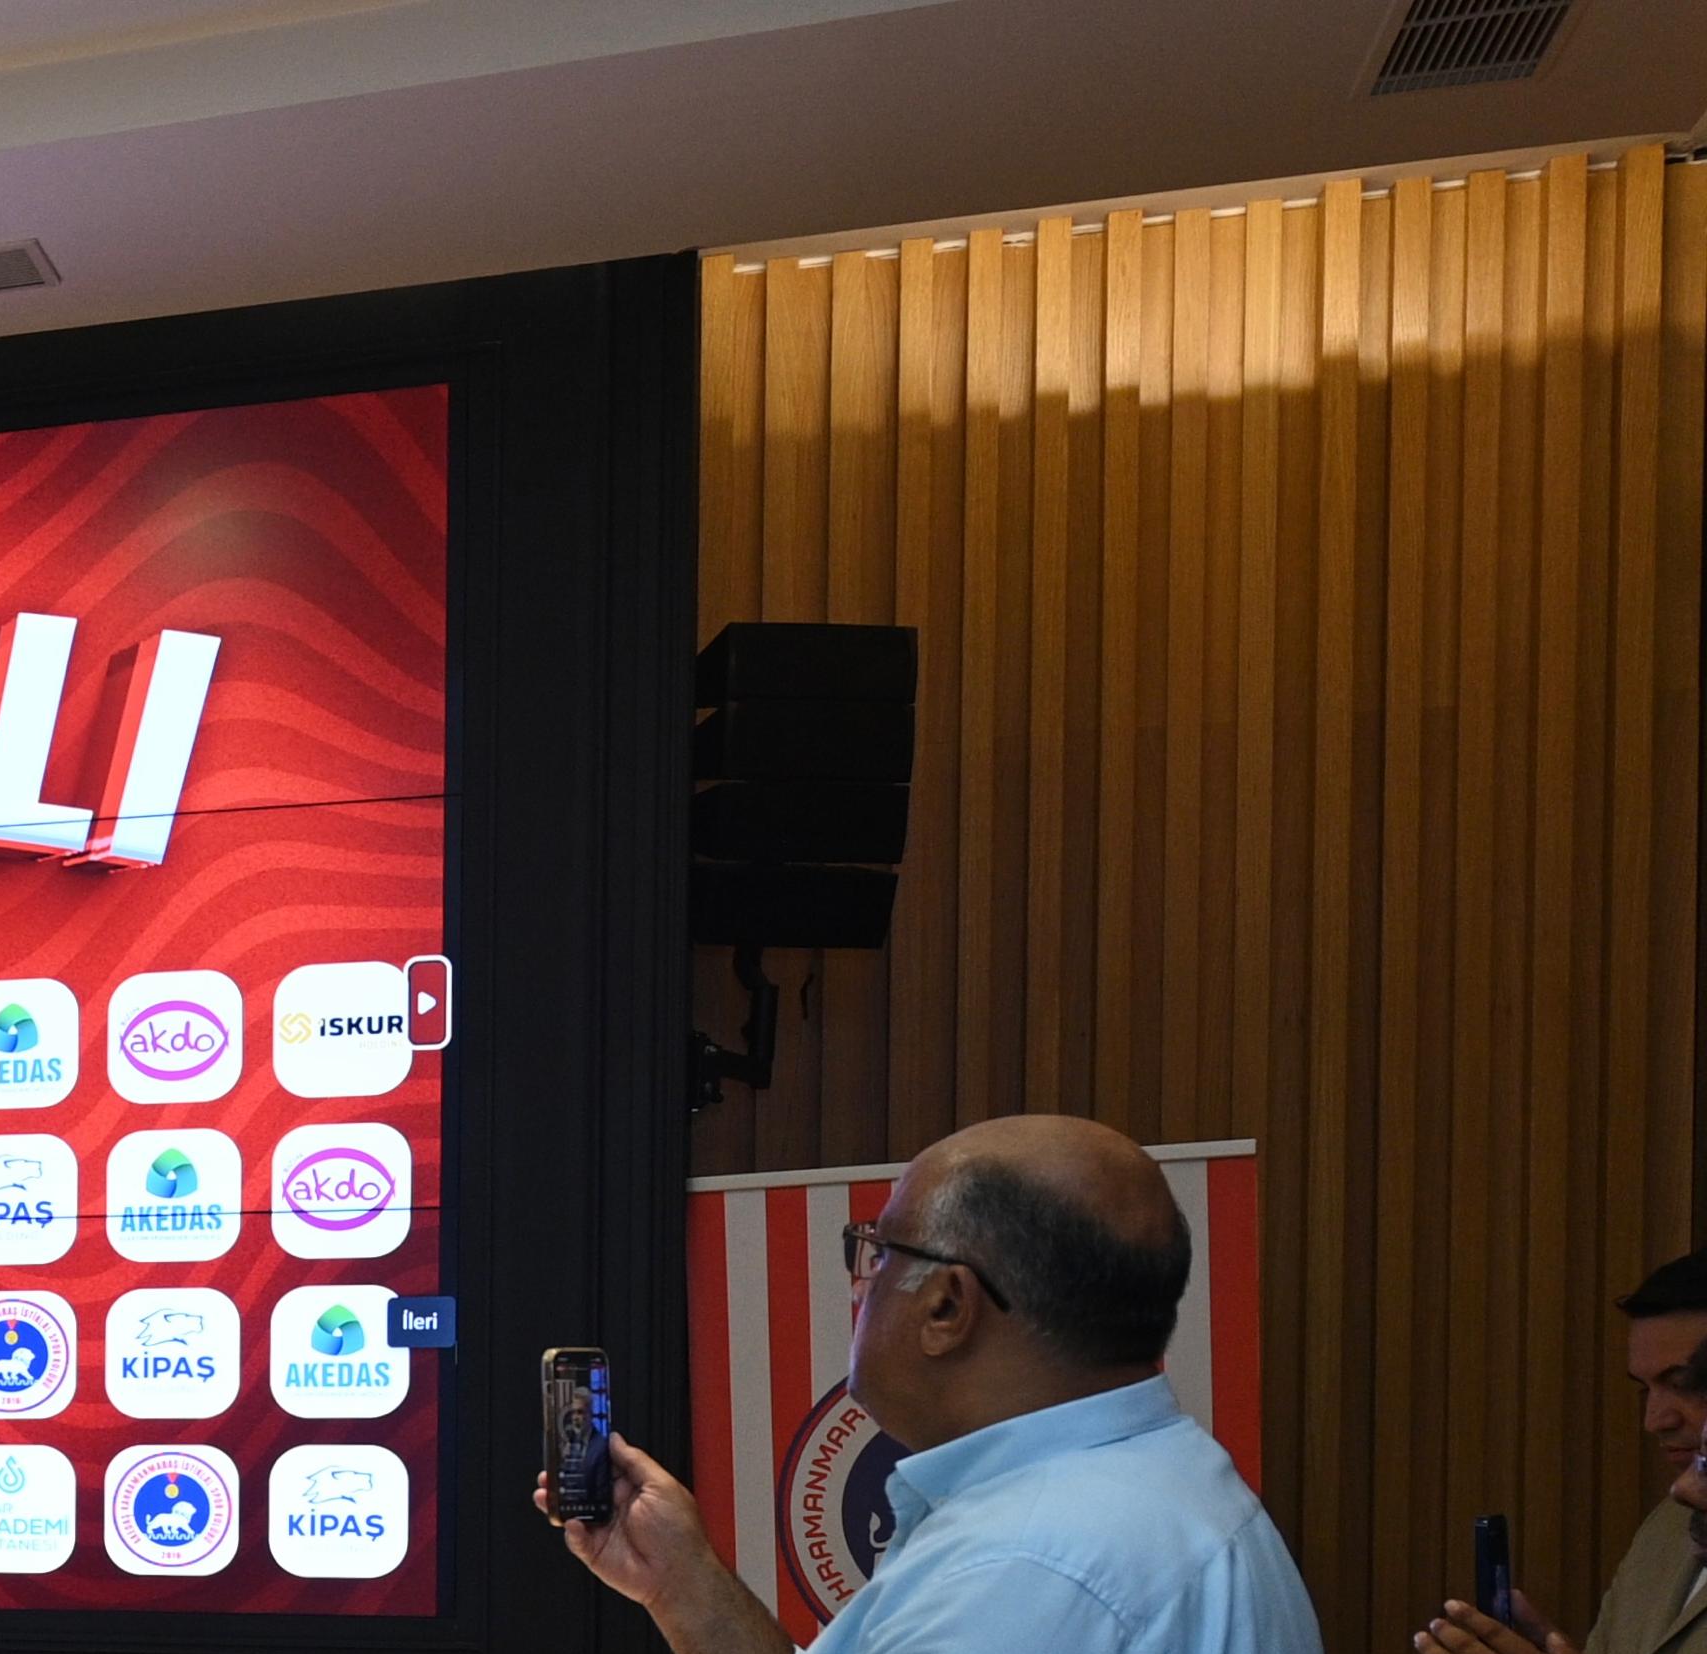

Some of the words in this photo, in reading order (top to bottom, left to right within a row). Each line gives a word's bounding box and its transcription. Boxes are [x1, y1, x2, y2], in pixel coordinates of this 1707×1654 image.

[131, 1021, 215, 1053] akdo
[293, 1168, 381, 1201] akdo
[402, 1309, 438, 1330] İleri
[122, 1351, 216, 1383] KİPAŞ
[289, 1509, 385, 1542] KİPAŞ
